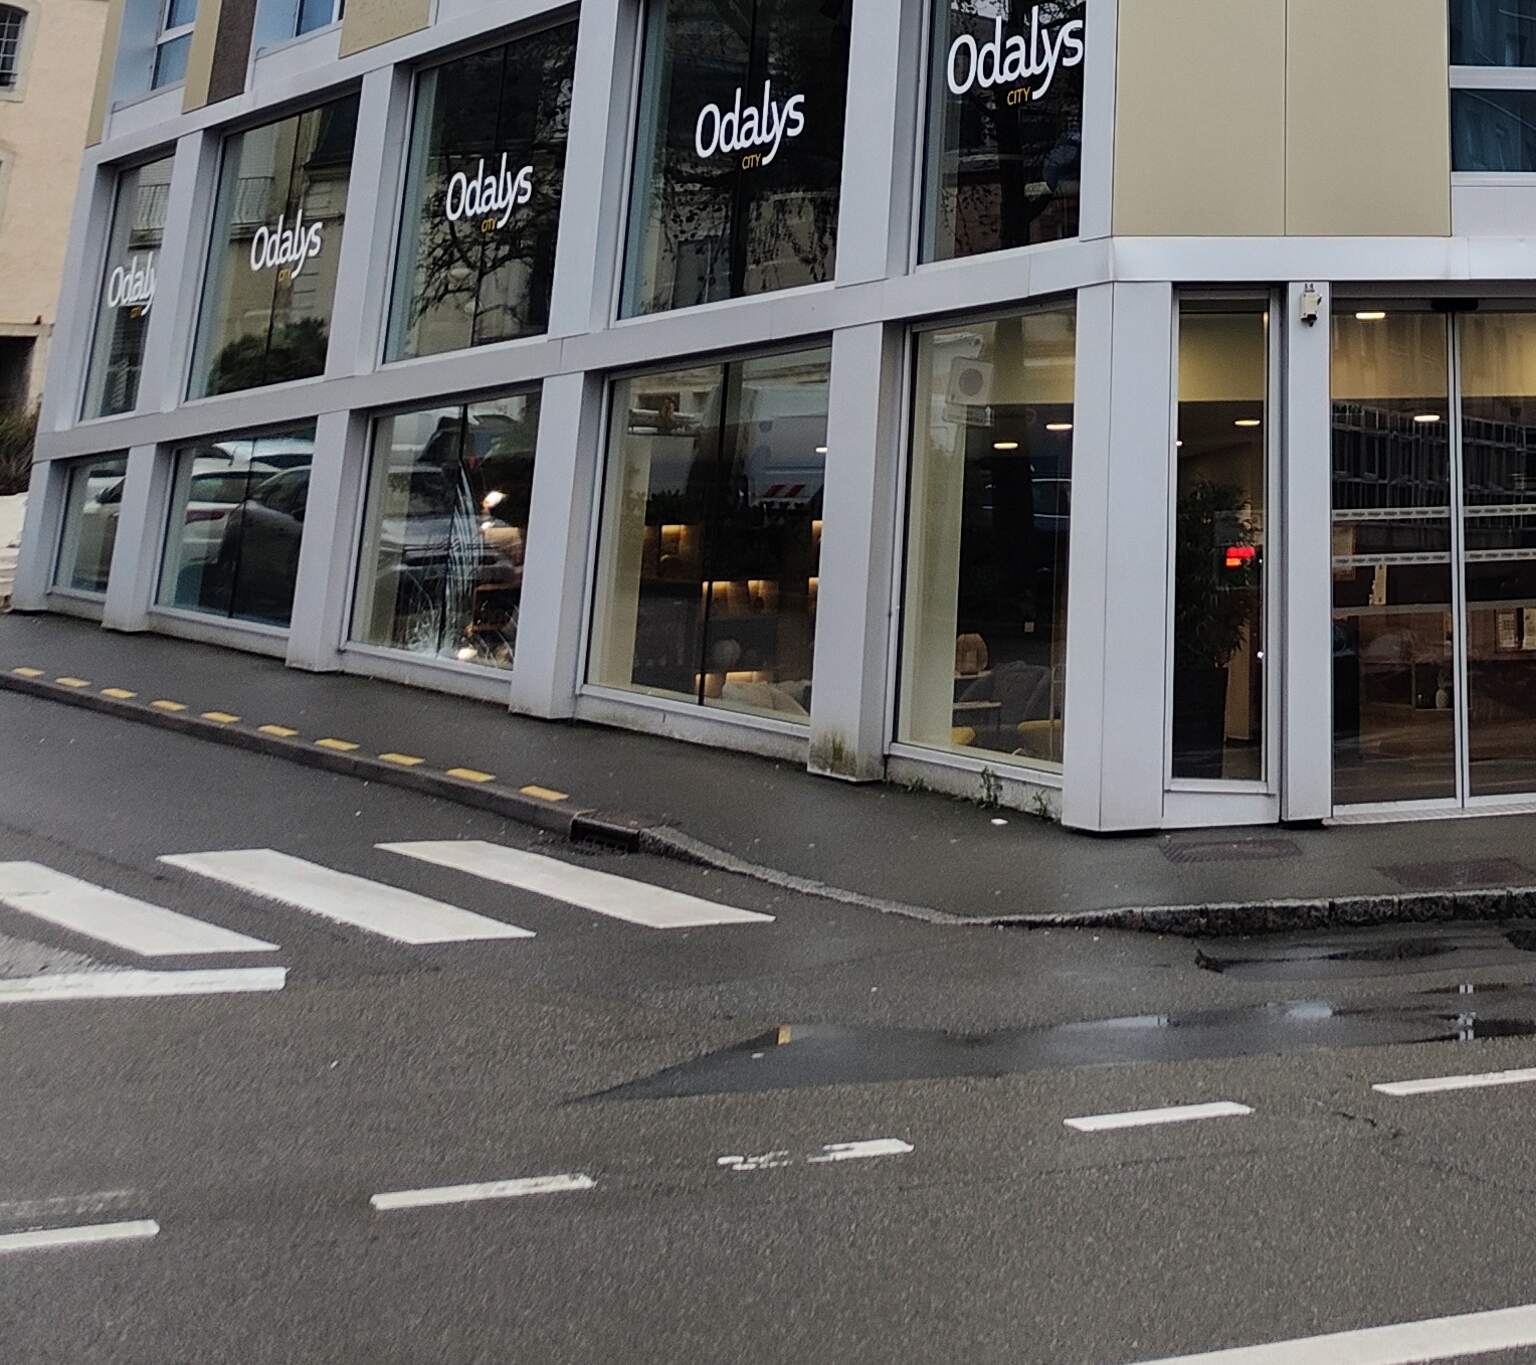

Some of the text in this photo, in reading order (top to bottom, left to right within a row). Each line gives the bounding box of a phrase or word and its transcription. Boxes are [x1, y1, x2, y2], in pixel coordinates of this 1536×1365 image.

[947, 5, 1085, 101] Odalys
[695, 79, 805, 166] Odalys
[1006, 85, 1032, 106] CITY
[446, 151, 534, 229] Odalys
[741, 152, 762, 170] CITY
[250, 208, 323, 280] Odalys
[107, 251, 157, 316] Odaly
